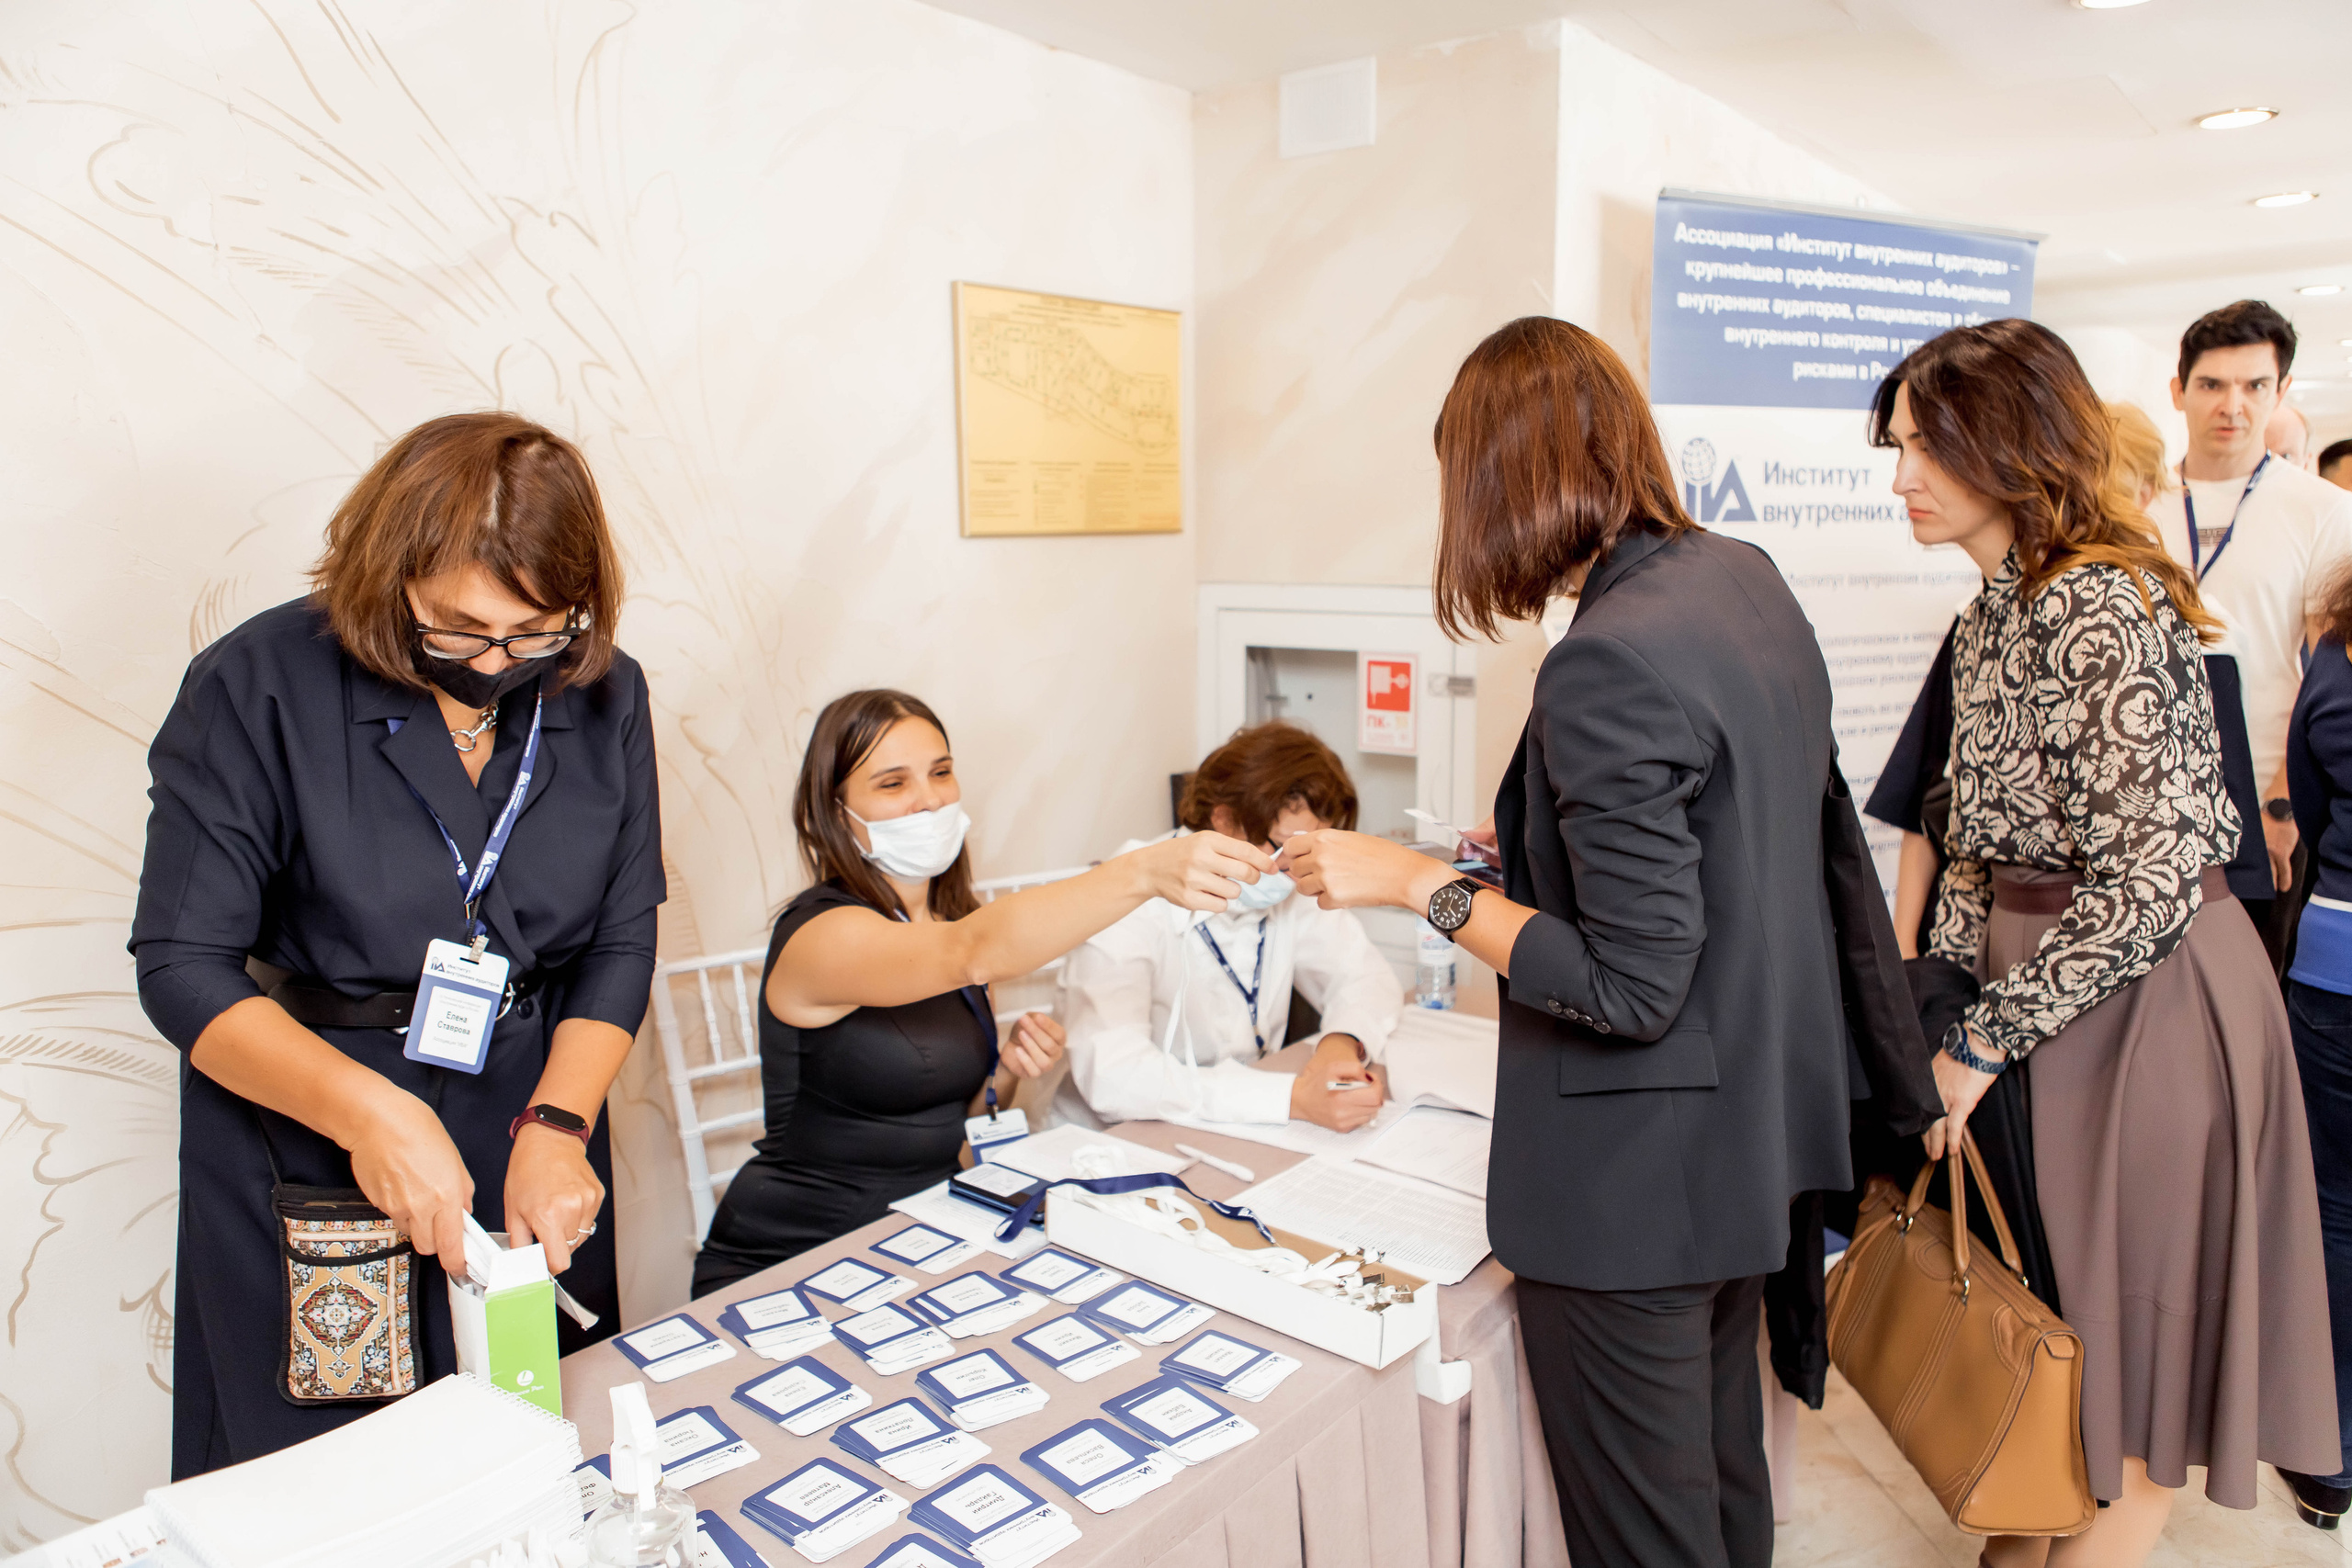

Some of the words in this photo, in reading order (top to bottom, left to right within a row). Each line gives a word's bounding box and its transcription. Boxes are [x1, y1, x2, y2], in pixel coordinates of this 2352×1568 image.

[1674, 221, 1773, 253] Ассоциация
[1776, 231, 1853, 263] «Институт
[1854, 243, 1934, 266] внутренних
[1685, 260, 1783, 283] крупнейшее
[1785, 265, 1924, 297] профессиональное
[1677, 292, 1770, 315] внутренних
[1772, 299, 1854, 321] аудиторов,
[1724, 327, 1820, 349] внутреннего
[1822, 333, 1888, 355] контроля
[1792, 361, 1856, 382] рисками
[1763, 460, 1871, 491] Институт
[1763, 503, 1893, 528] внутренних
[447, 1011, 468, 1023] Елена
[437, 1021, 470, 1035] Ставрова
[967, 1373, 986, 1382] Олег
[783, 1385, 807, 1398] Елена
[1159, 1403, 1186, 1416] Бабкин
[1167, 1407, 1193, 1421] Андрей
[873, 1416, 914, 1434] Лопаткина
[886, 1423, 912, 1436] Ирина
[662, 1428, 694, 1443] Тюрина
[669, 1433, 699, 1447] Оксана
[1064, 1443, 1104, 1465] Васильева
[1079, 1451, 1104, 1466] Олеся
[797, 1481, 831, 1500] Матвеев
[801, 1483, 842, 1506] Александр
[963, 1489, 998, 1509] Гайдарь
[970, 1494, 1006, 1515] Дмитрий
